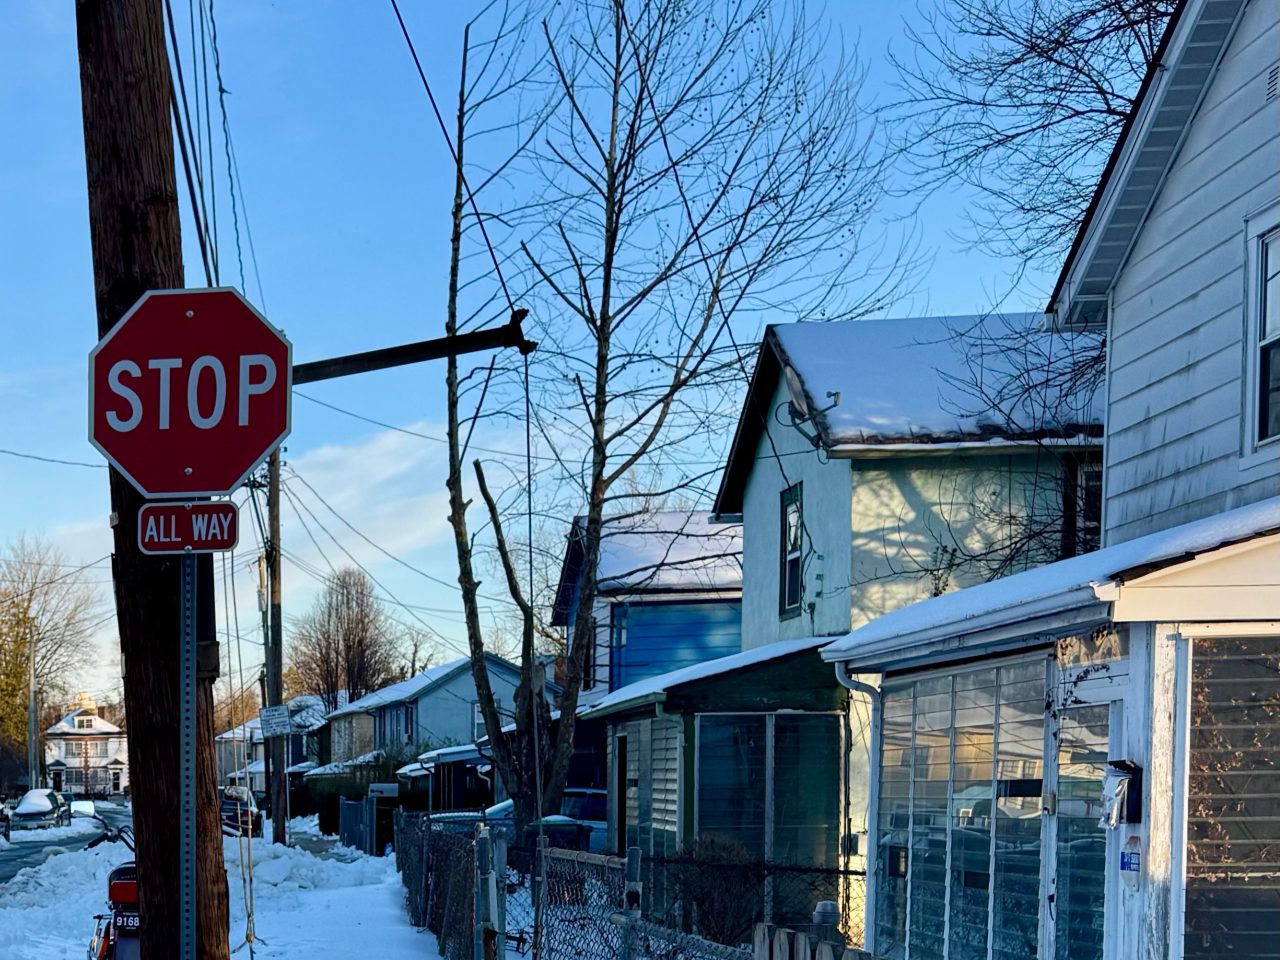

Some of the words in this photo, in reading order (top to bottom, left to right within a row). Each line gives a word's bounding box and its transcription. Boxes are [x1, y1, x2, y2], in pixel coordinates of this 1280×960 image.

[105, 354, 277, 433] STOP
[144, 514, 182, 543] ALL
[191, 512, 233, 541] WAY
[116, 916, 140, 927] 9168
